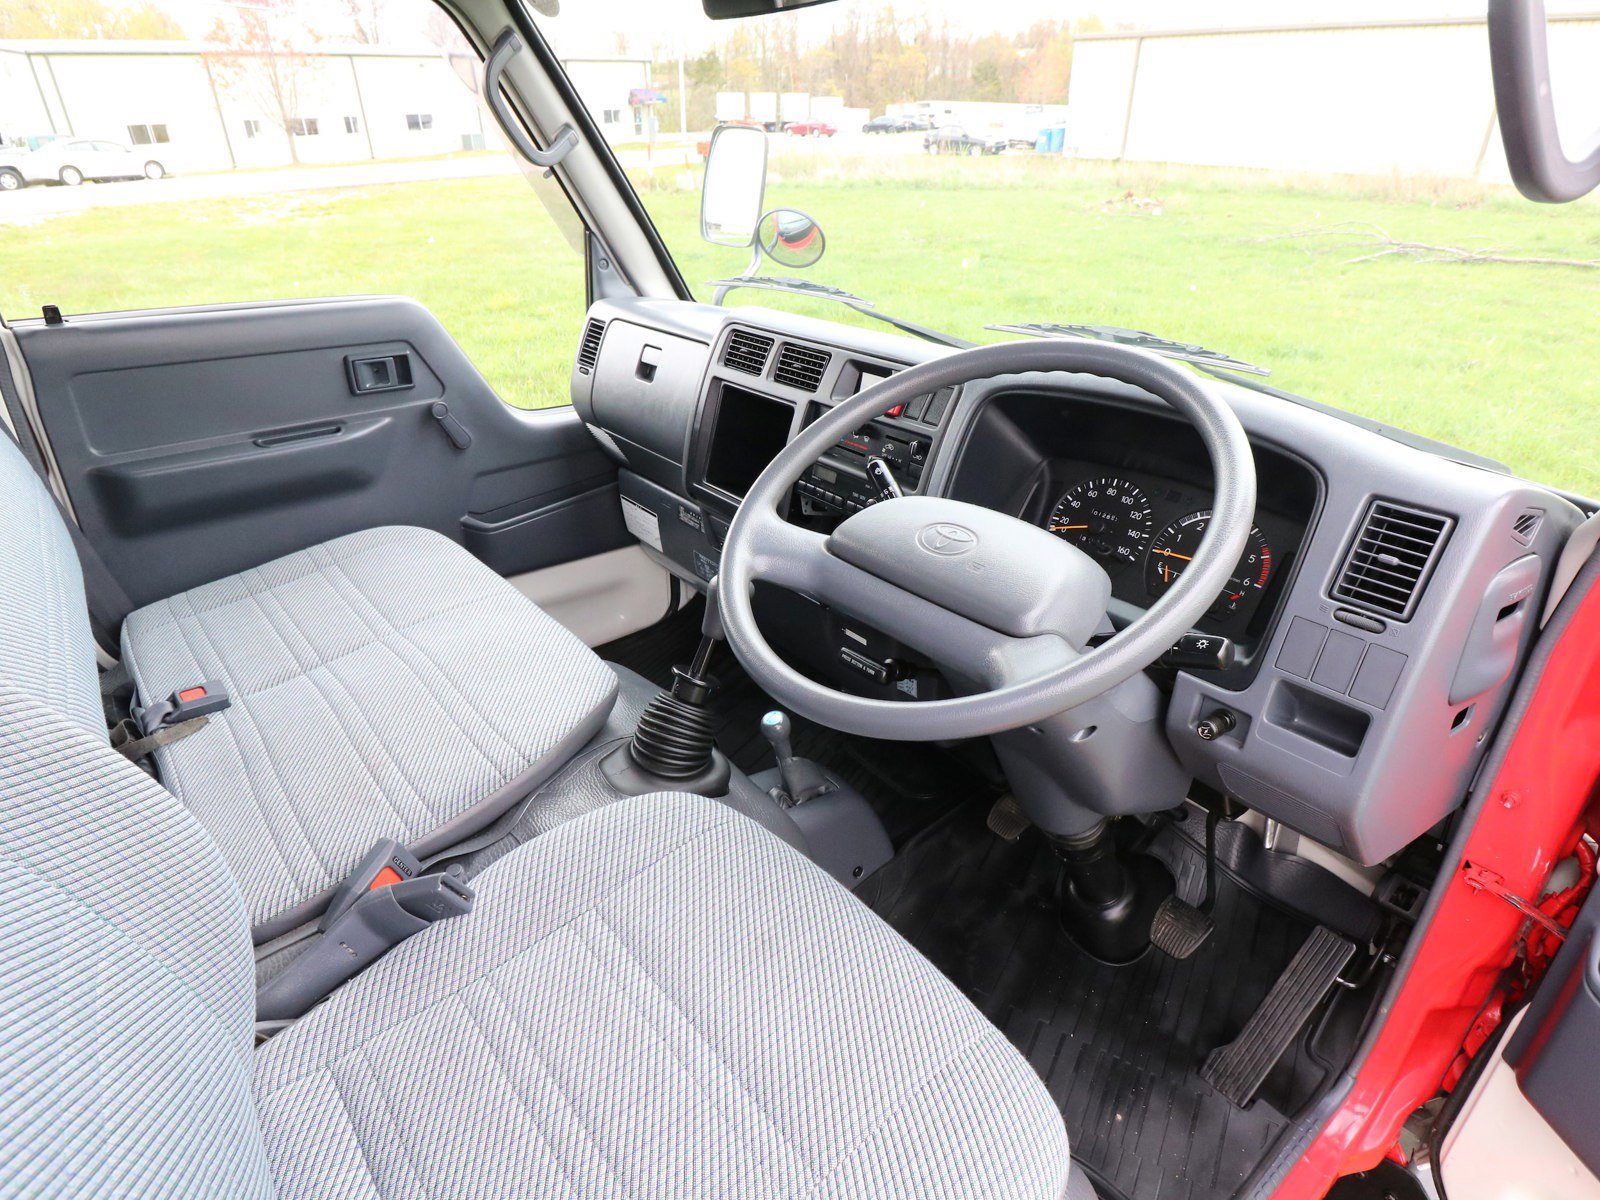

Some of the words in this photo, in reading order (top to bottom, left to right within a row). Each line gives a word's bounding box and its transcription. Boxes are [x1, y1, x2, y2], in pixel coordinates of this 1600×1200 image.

[1087, 490, 1098, 498] 60
[1106, 488, 1117, 496] 80
[1121, 495, 1134, 505] 100
[1070, 501, 1081, 509] 40
[1129, 511, 1143, 520] 120
[1059, 517, 1070, 525] 20
[1196, 522, 1204, 531] 2
[1127, 529, 1141, 539] 140
[1176, 534, 1182, 542] 1
[1117, 546, 1131, 556] 160
[1163, 547, 1172, 556] 0
[1247, 554, 1257, 563] 5
[1243, 577, 1251, 586] 6
[394, 857, 411, 876] CENTER
